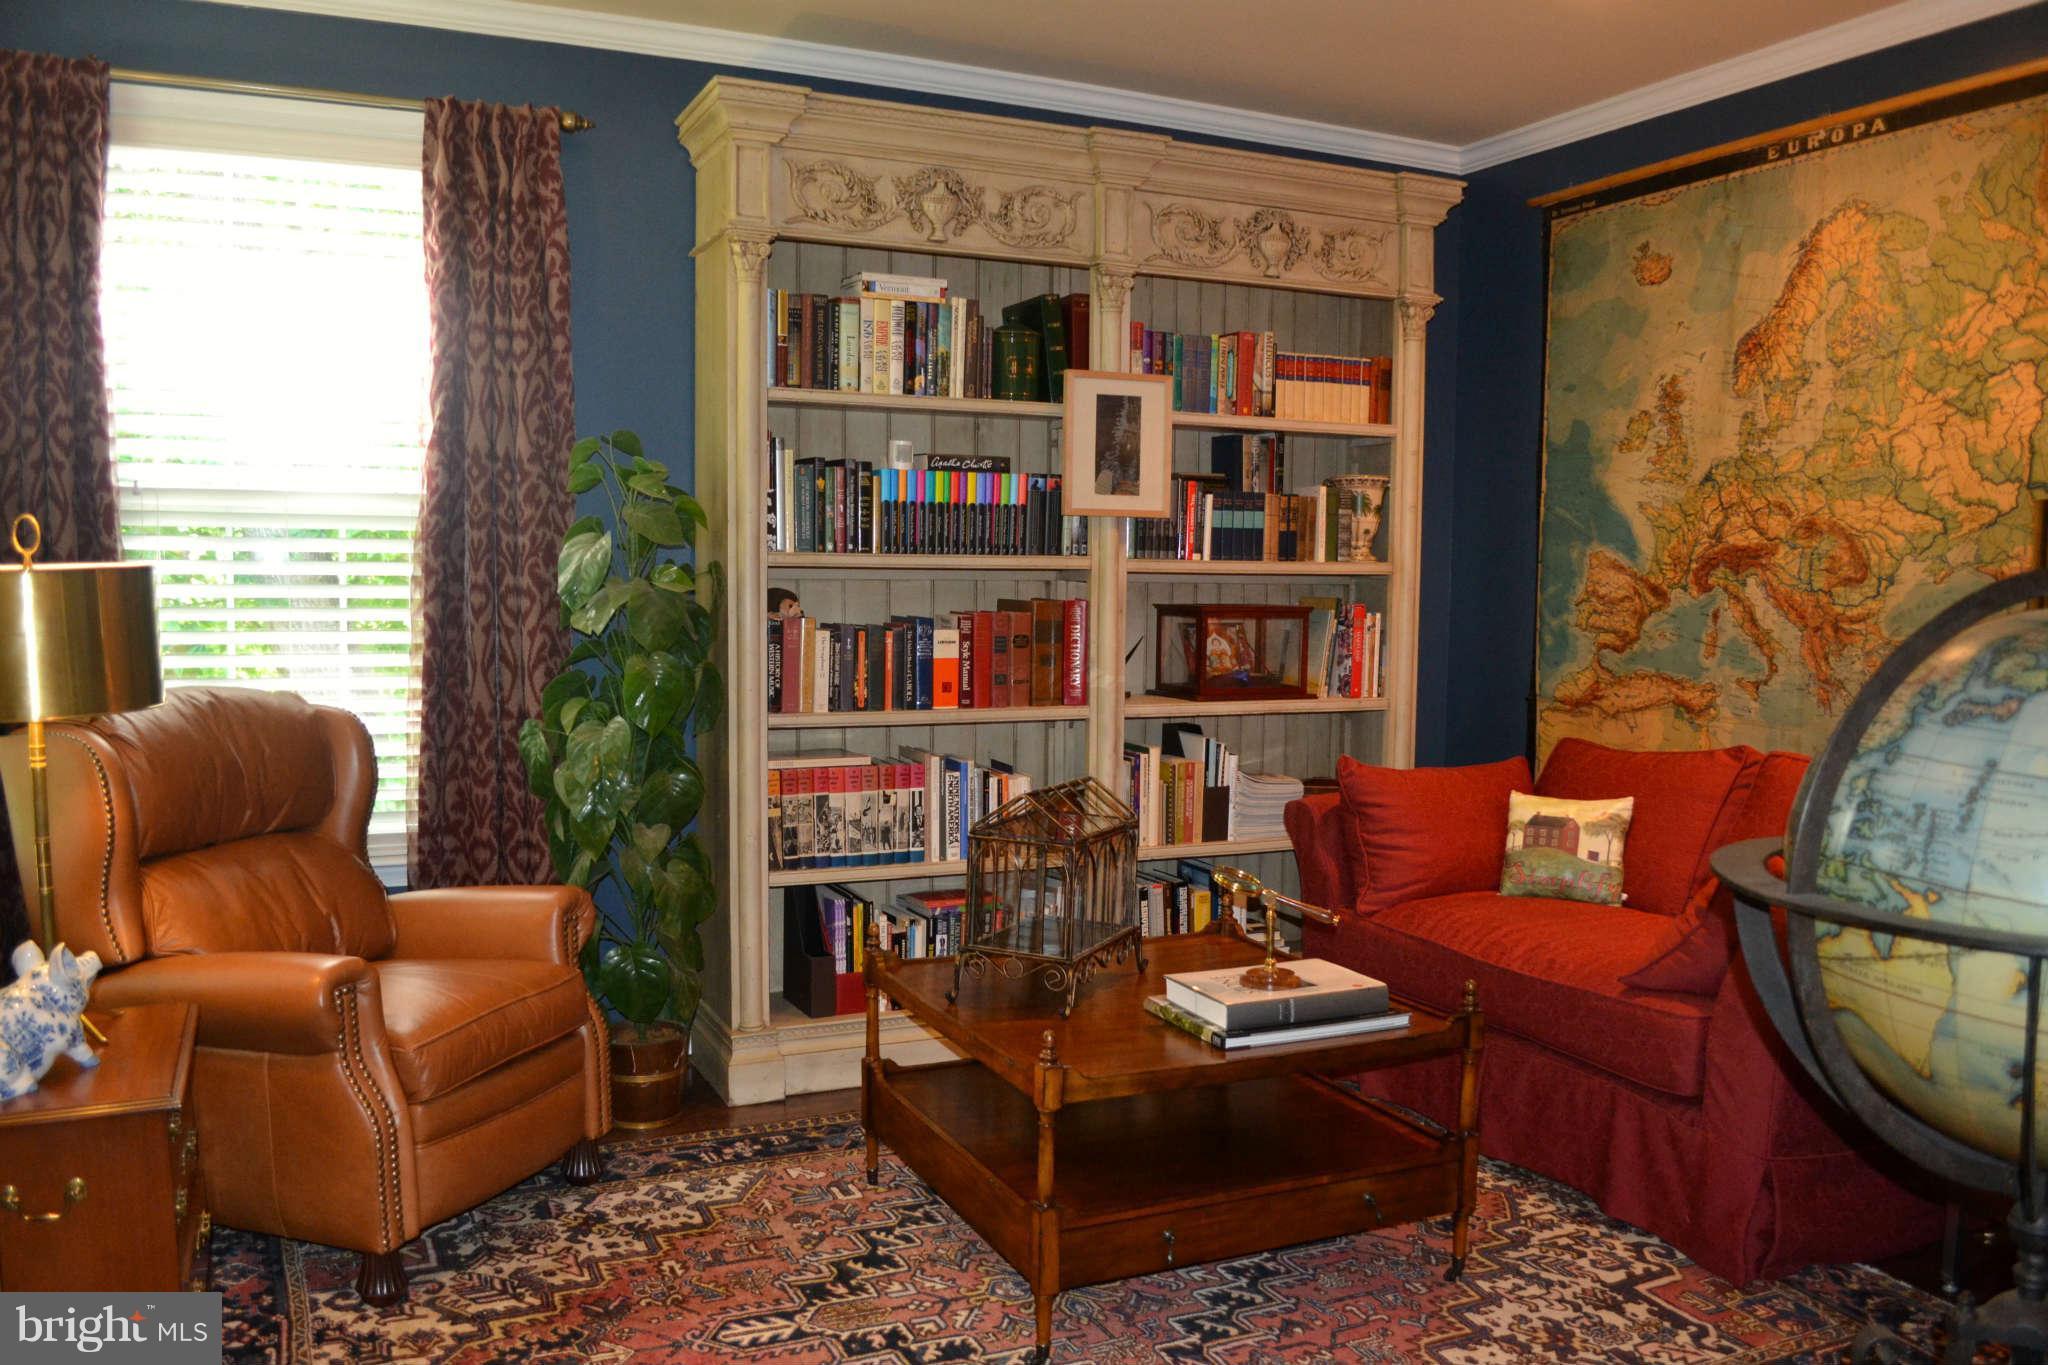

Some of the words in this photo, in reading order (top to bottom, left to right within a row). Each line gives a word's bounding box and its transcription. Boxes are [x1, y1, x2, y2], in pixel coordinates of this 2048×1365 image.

[1767, 117, 1886, 160] EUROPA
[1265, 334, 1273, 378] MEDICUS
[931, 456, 960, 468] Agatha
[962, 459, 993, 469] Christie
[960, 641, 970, 659] Style
[1070, 624, 1081, 688] DICTIONARY
[775, 679, 781, 688] OF
[962, 661, 970, 690] Manual
[1510, 862, 1622, 901] Simplify
